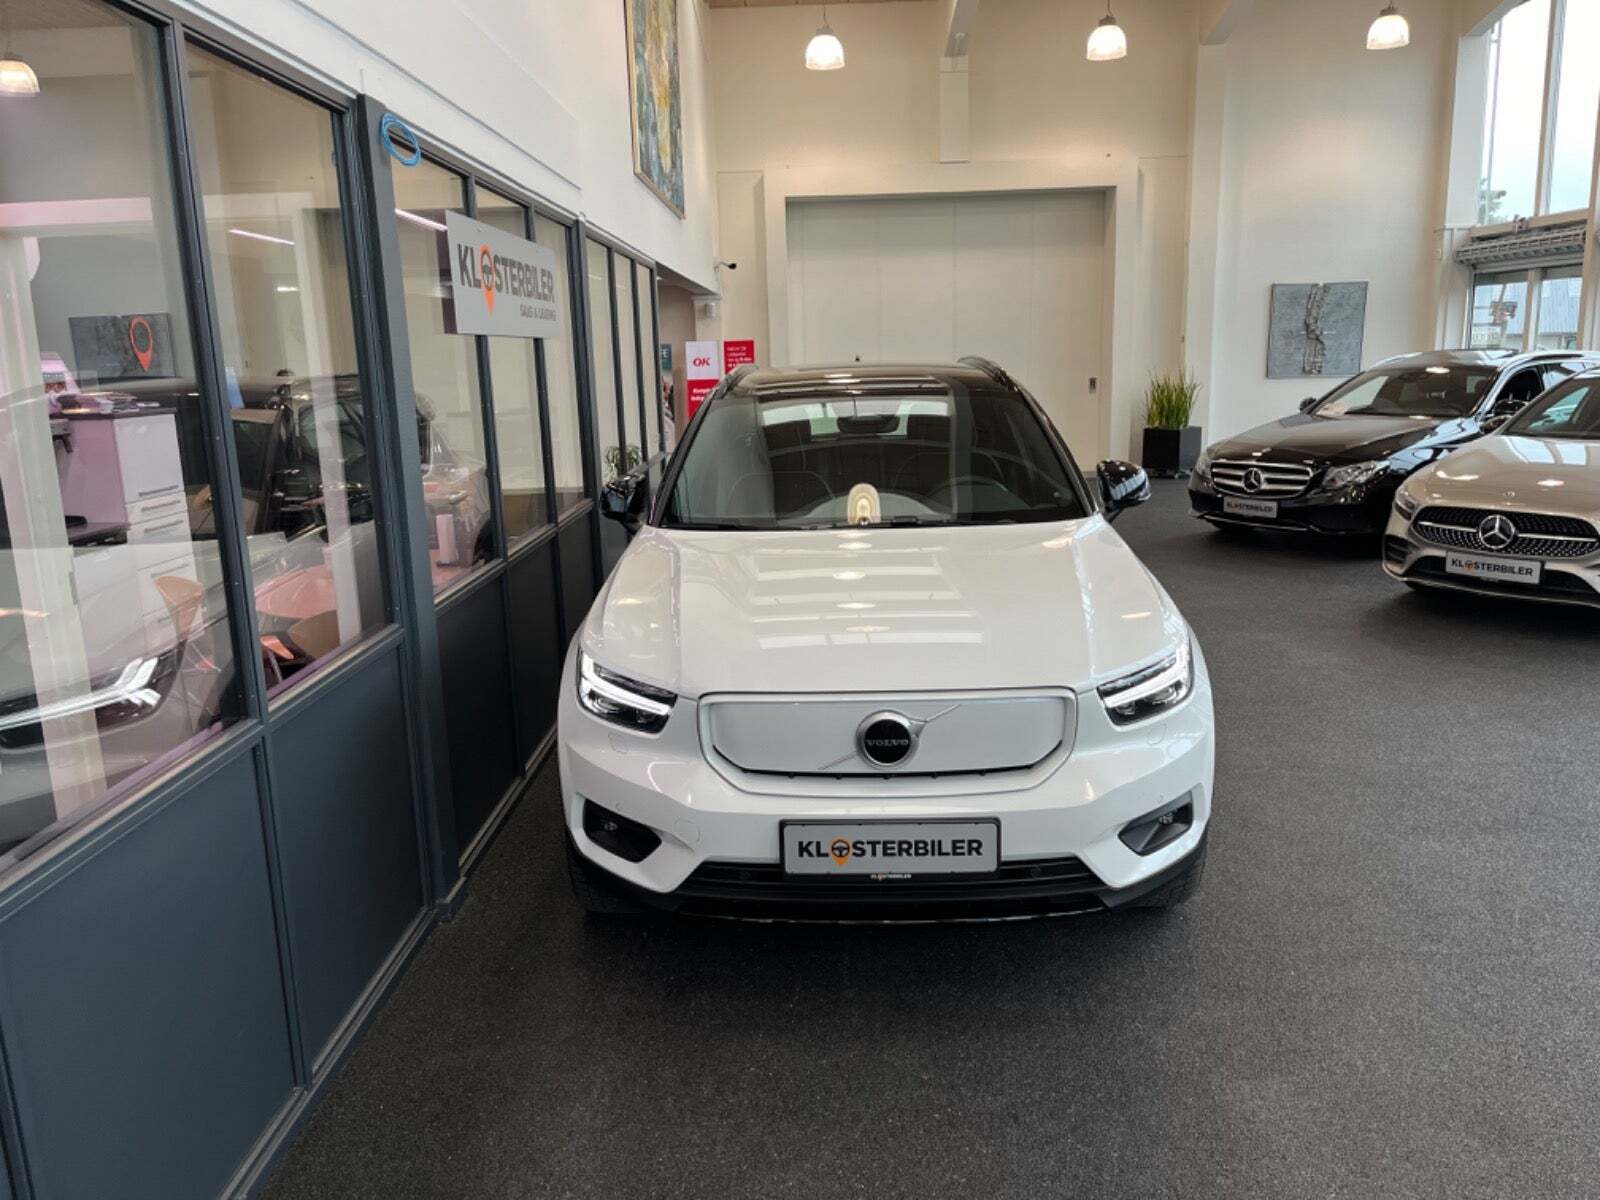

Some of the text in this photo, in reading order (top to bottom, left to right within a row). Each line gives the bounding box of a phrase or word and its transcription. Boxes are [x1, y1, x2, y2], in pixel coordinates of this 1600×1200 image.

[457, 243, 555, 304] KLOSTERBILER
[693, 357, 711, 367] OK
[1451, 558, 1534, 577] KLOSTERBILER
[866, 739, 909, 747] VOLVO
[798, 838, 983, 859] KLOSTERBILER
